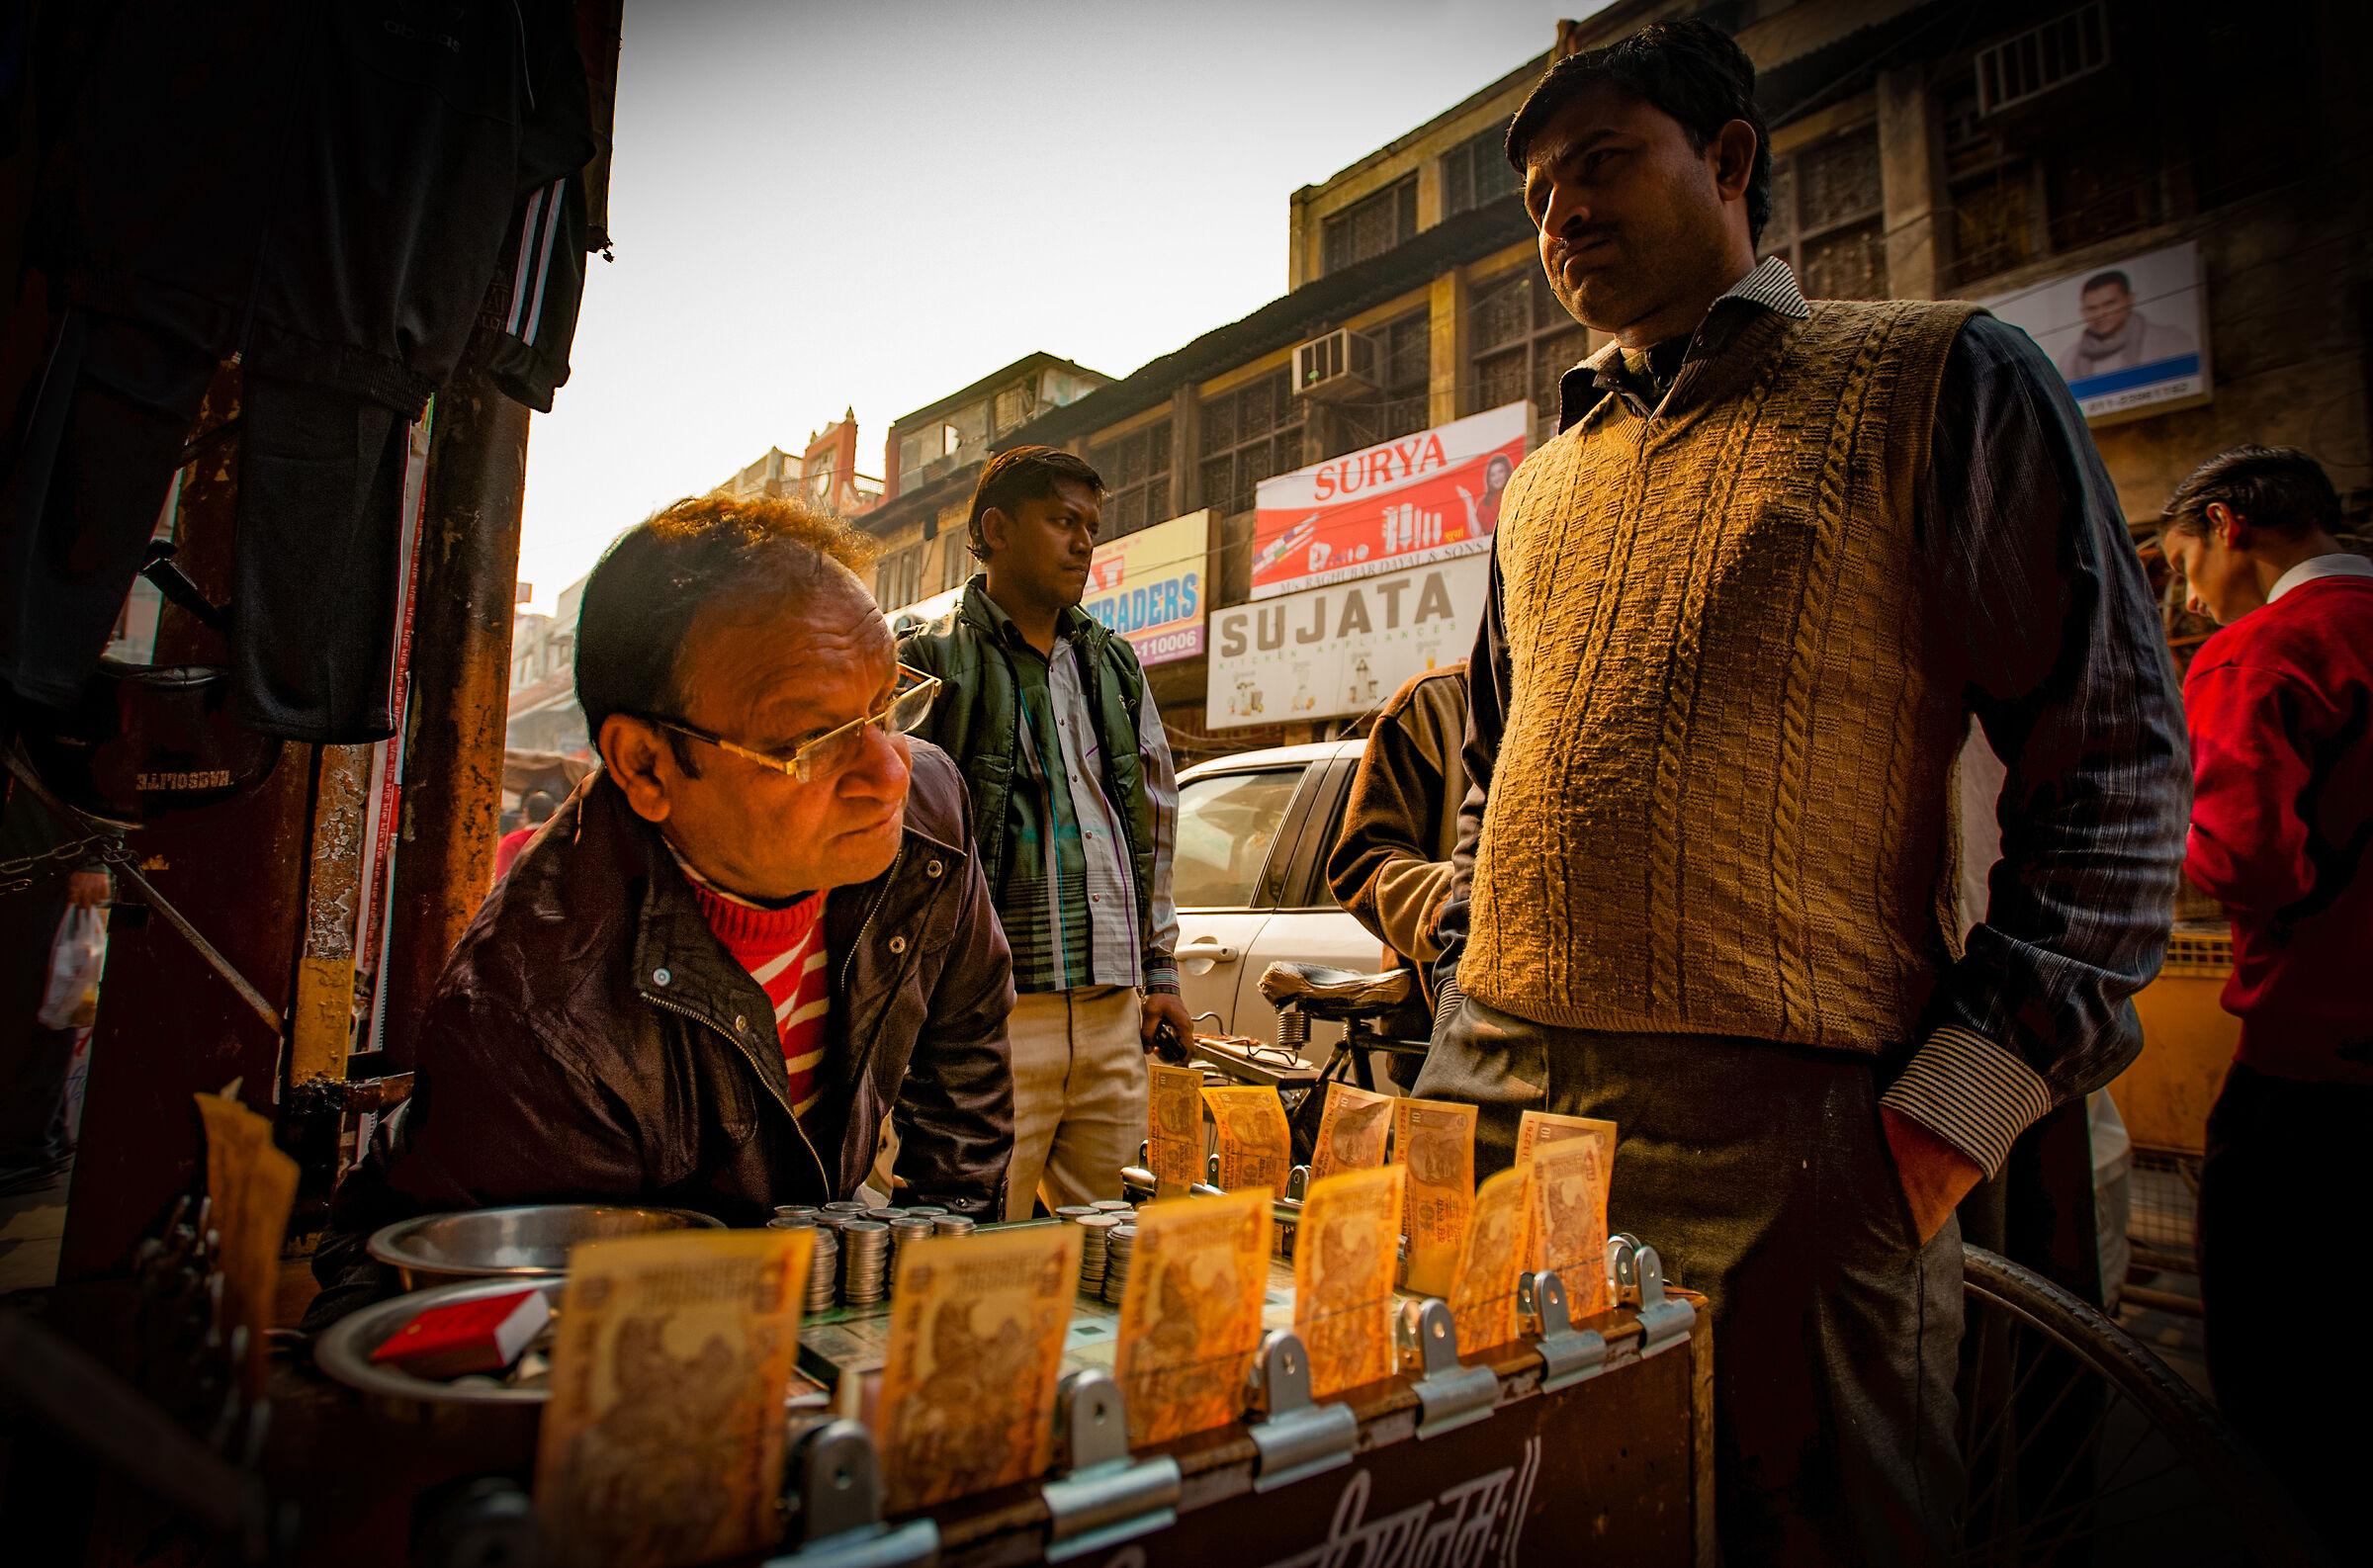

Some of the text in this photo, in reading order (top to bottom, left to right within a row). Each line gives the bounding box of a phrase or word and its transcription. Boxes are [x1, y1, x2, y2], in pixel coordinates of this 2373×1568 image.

[1314, 432, 1448, 501] SURYA
[1380, 554, 1421, 573] DAYAL
[1220, 571, 1453, 657] SUJATA
[1218, 650, 1297, 670] KITCHEN
[1317, 622, 1456, 653] APPLIANCES
[1540, 1126, 1551, 1139] 10
